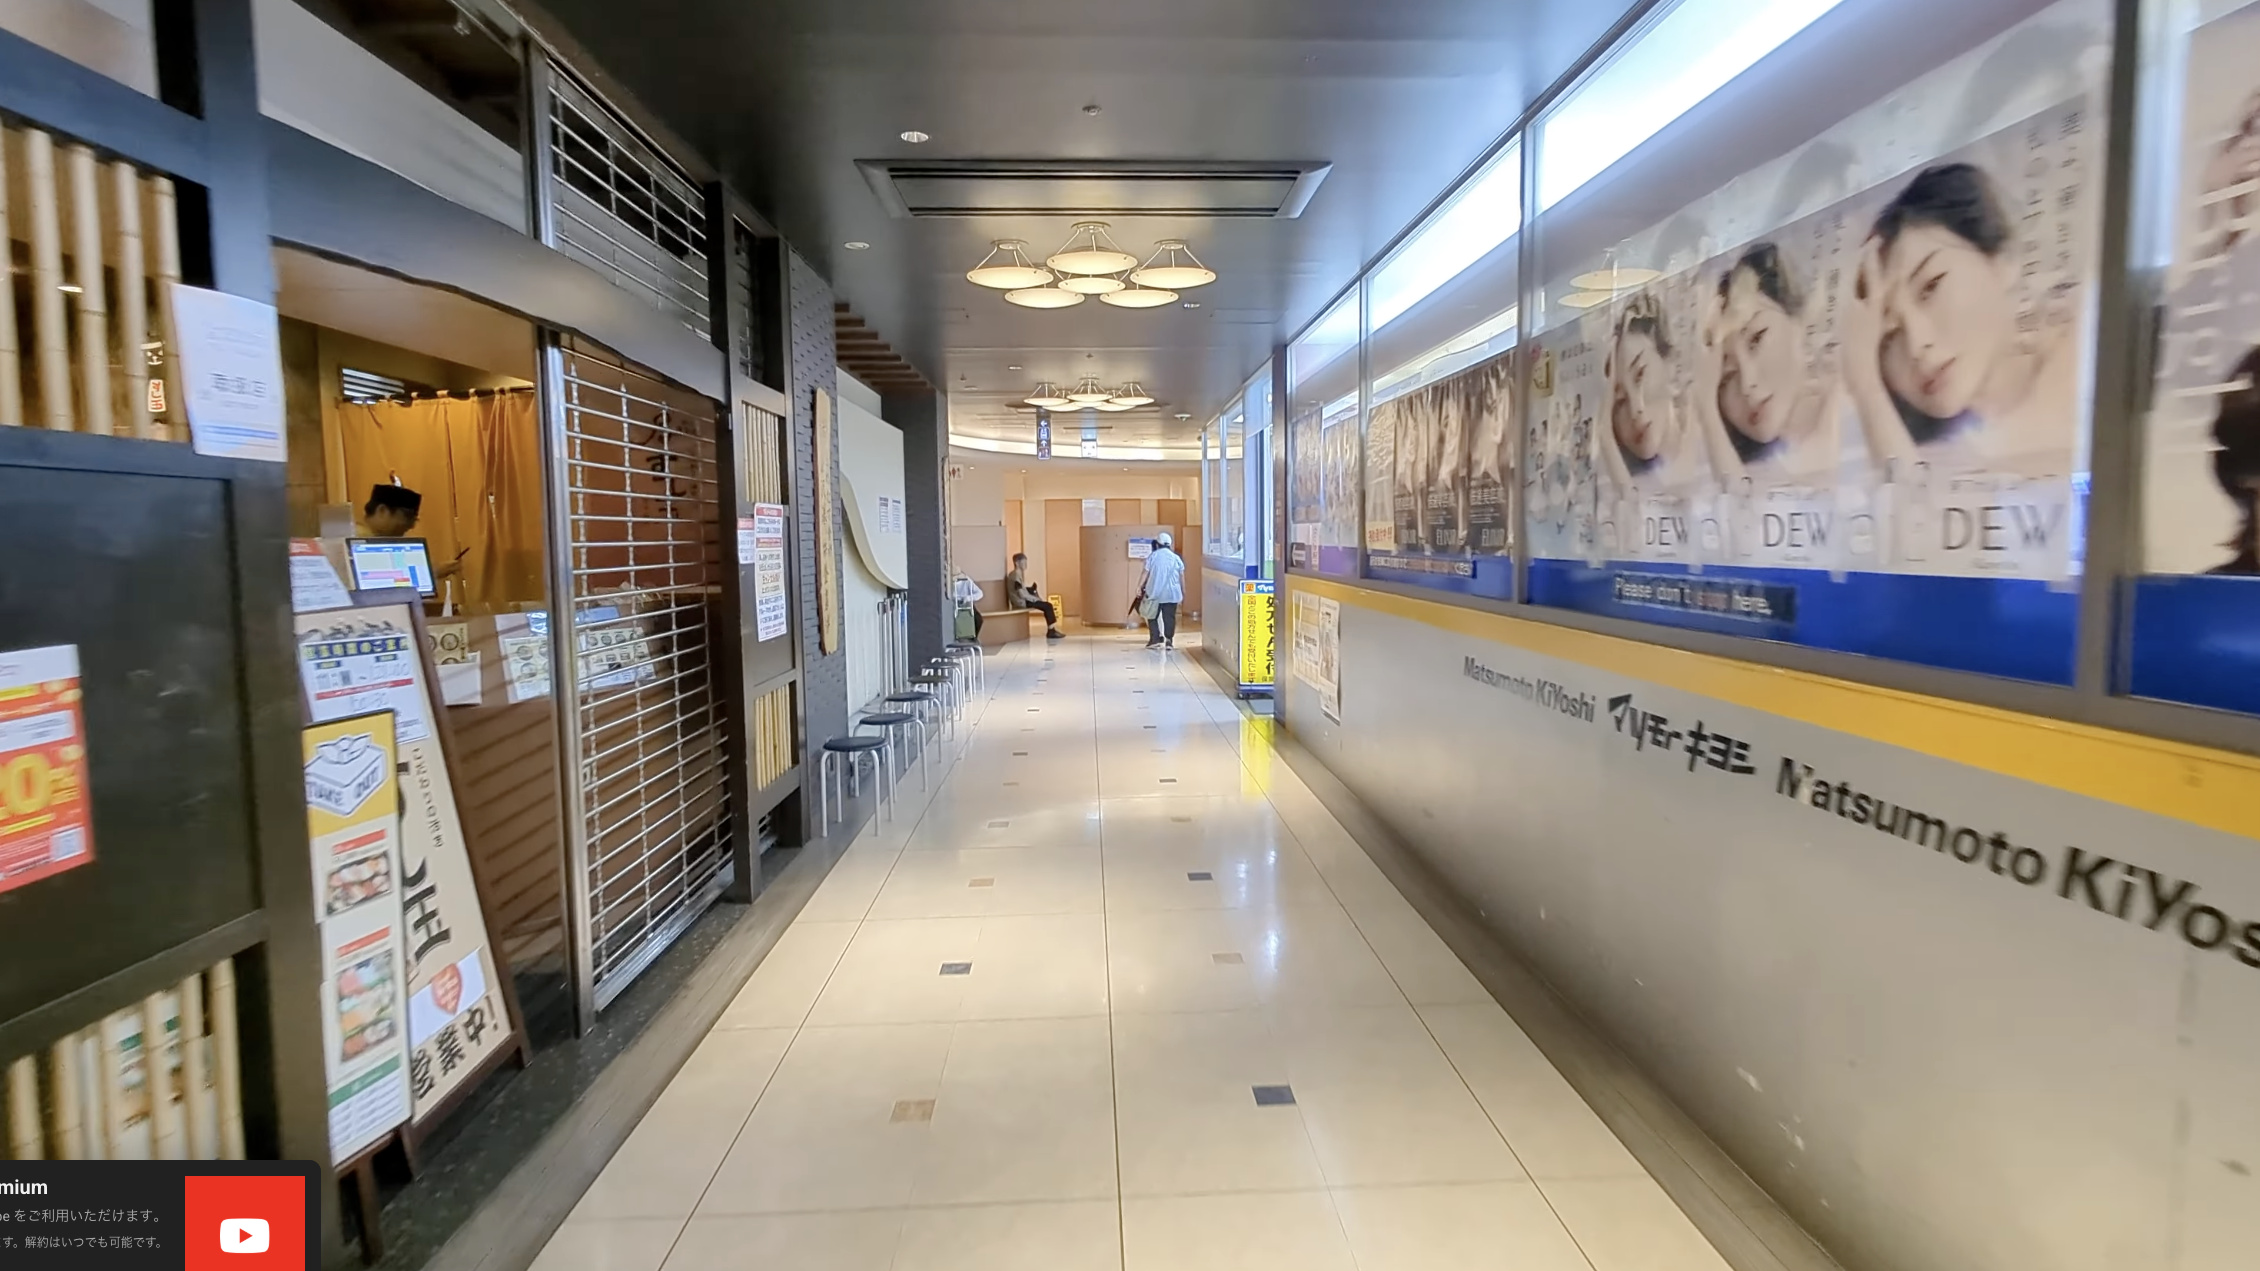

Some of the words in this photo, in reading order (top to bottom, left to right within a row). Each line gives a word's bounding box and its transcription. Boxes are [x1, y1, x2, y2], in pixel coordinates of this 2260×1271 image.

[1645, 517, 1689, 546] DEW
[1764, 512, 1833, 547] DEW
[1944, 505, 2065, 551] DEW
[1615, 577, 1652, 600] Please
[1656, 583, 1691, 604] don't
[1463, 656, 1534, 700] Matsumoto
[1535, 678, 1596, 724] KiYoshi
[1608, 693, 1758, 773] マツモトキヨシ
[1775, 756, 2047, 886] Matsumoto
